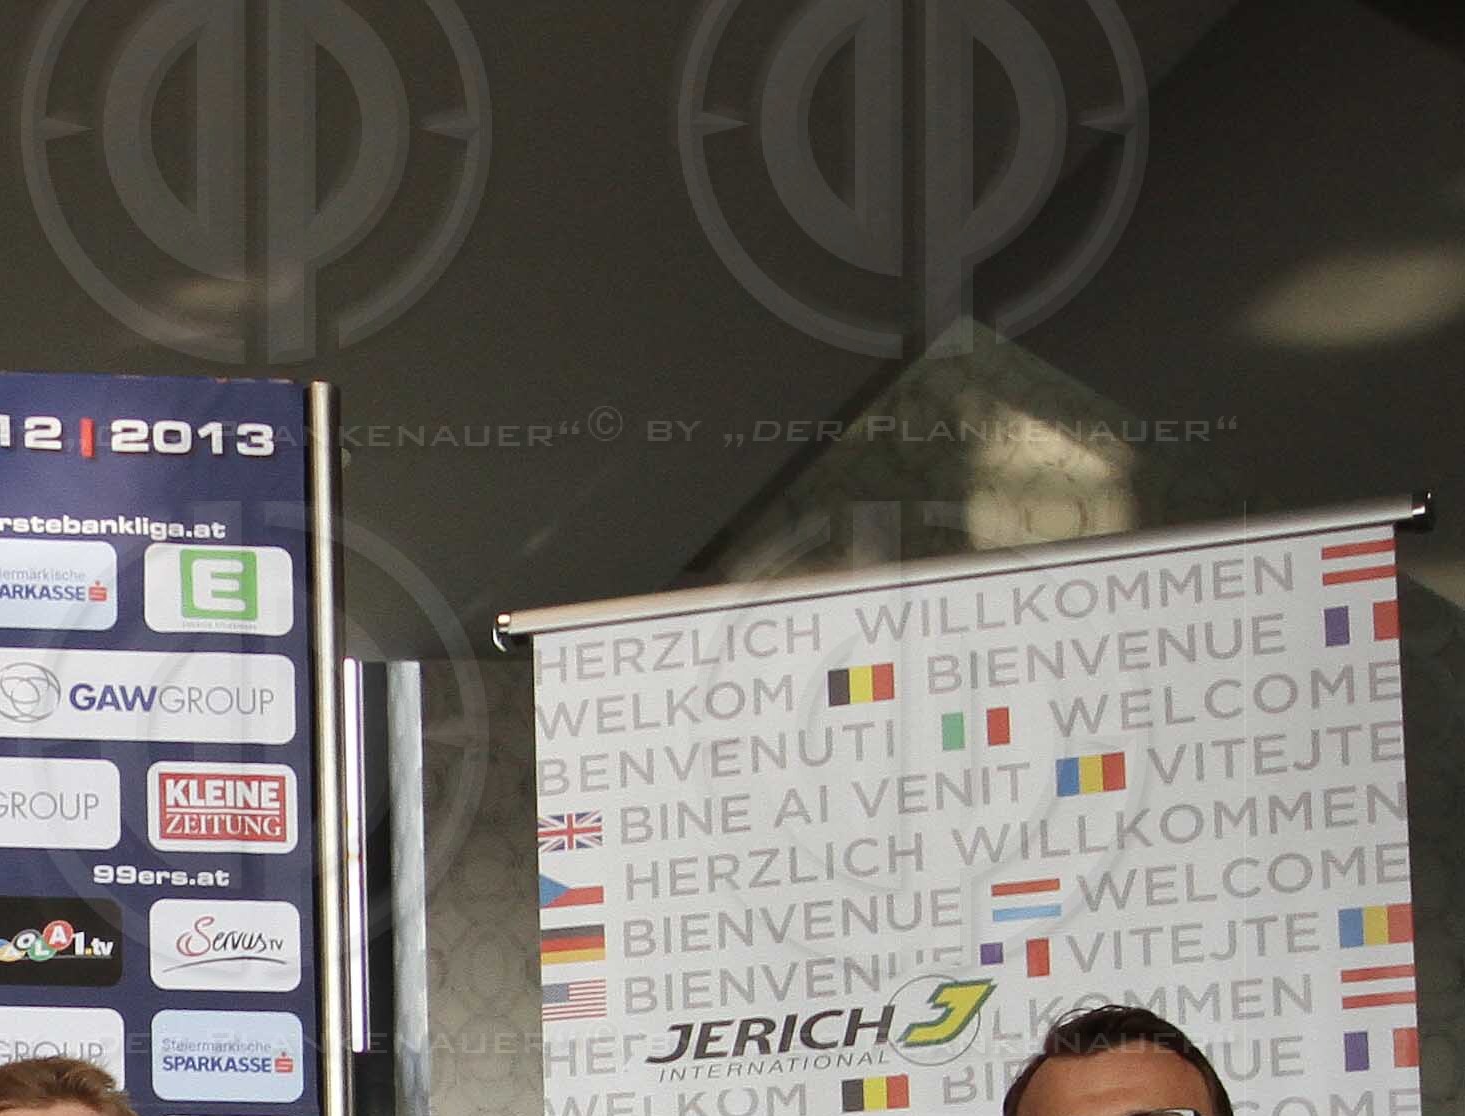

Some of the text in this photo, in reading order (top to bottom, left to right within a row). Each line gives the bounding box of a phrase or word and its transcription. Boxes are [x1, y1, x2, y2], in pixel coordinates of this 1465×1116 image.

[111, 419, 274, 457] 2013
[535, 552, 1294, 685] HERZLICH WILLKOMMEN
[536, 612, 1287, 740] WELKOM BIENVENUE
[538, 661, 1400, 796] BENVENUTI WELCOME
[165, 779, 280, 808] KLEINE
[621, 720, 1402, 845] BINE AI VENIT VITEJTE
[165, 814, 283, 837] ZEITUNG
[626, 781, 1407, 899] HERZLICH WILLKOMMEN
[93, 865, 230, 887] 99ers.at
[624, 843, 1407, 958] BIENVENUE WELCOME
[1066, 911, 1320, 974] VITEJTE
[162, 1038, 272, 1054] Steiermärkische
[645, 1004, 895, 1064] JERICH
[163, 1055, 273, 1074] SPARKASSE
[659, 1049, 891, 1082] INTERNATIONAL
